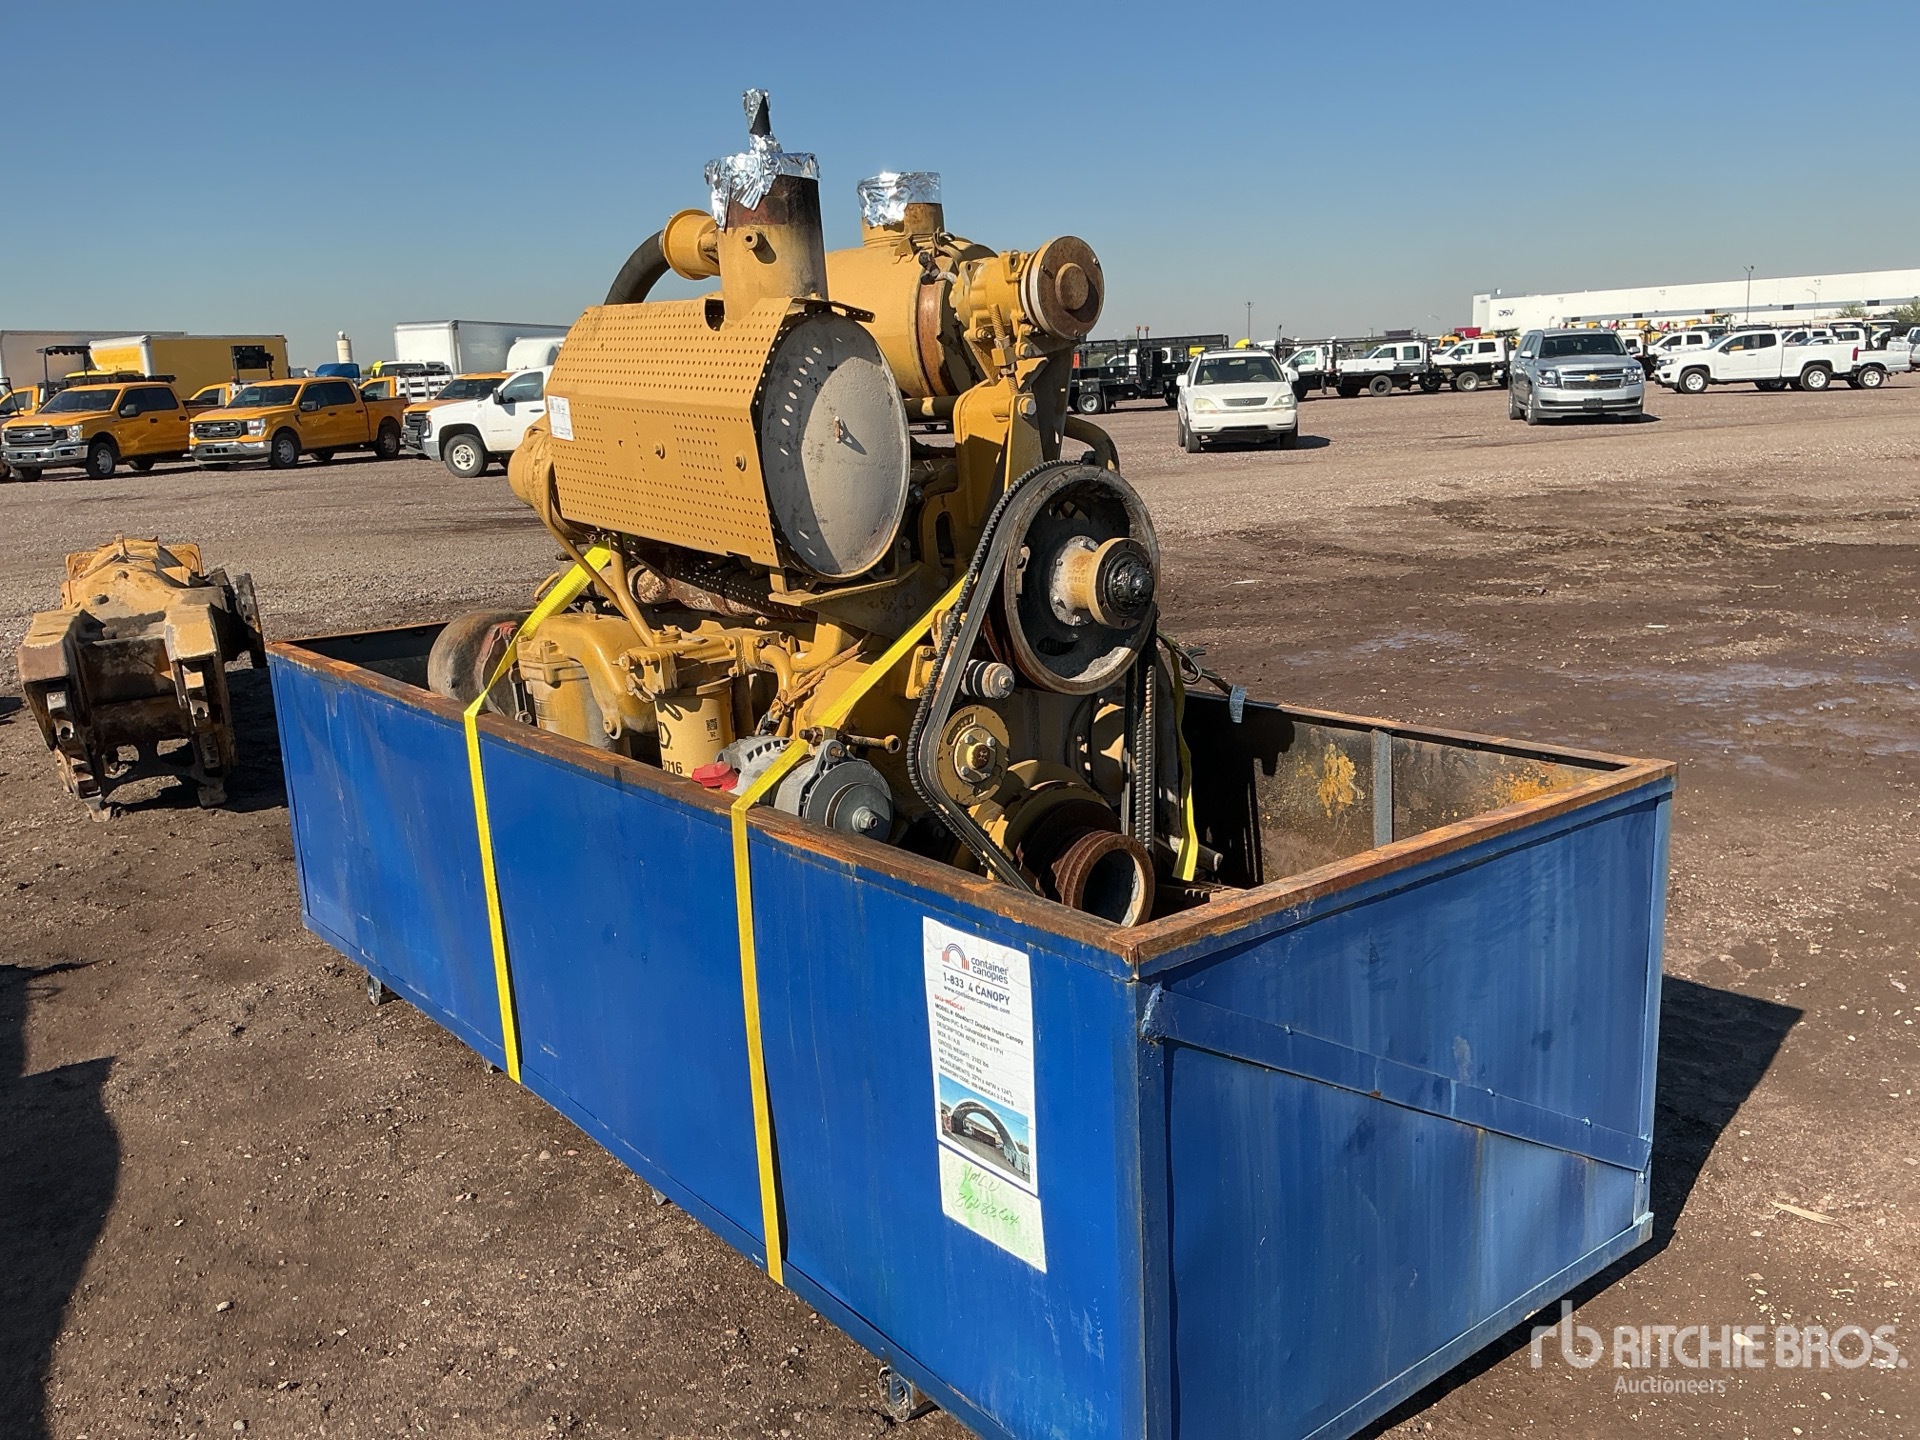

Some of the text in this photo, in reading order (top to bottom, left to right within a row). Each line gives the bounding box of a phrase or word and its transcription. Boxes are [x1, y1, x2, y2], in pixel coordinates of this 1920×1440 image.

[971, 957, 1009, 976] container
[972, 965, 1009, 985] canopies
[943, 972, 1010, 1006] 1-833 4 CANOPY
[975, 1021, 991, 1032] Double
[991, 1027, 1005, 1037] Truss
[1005, 1033, 1024, 1046] Canopy
